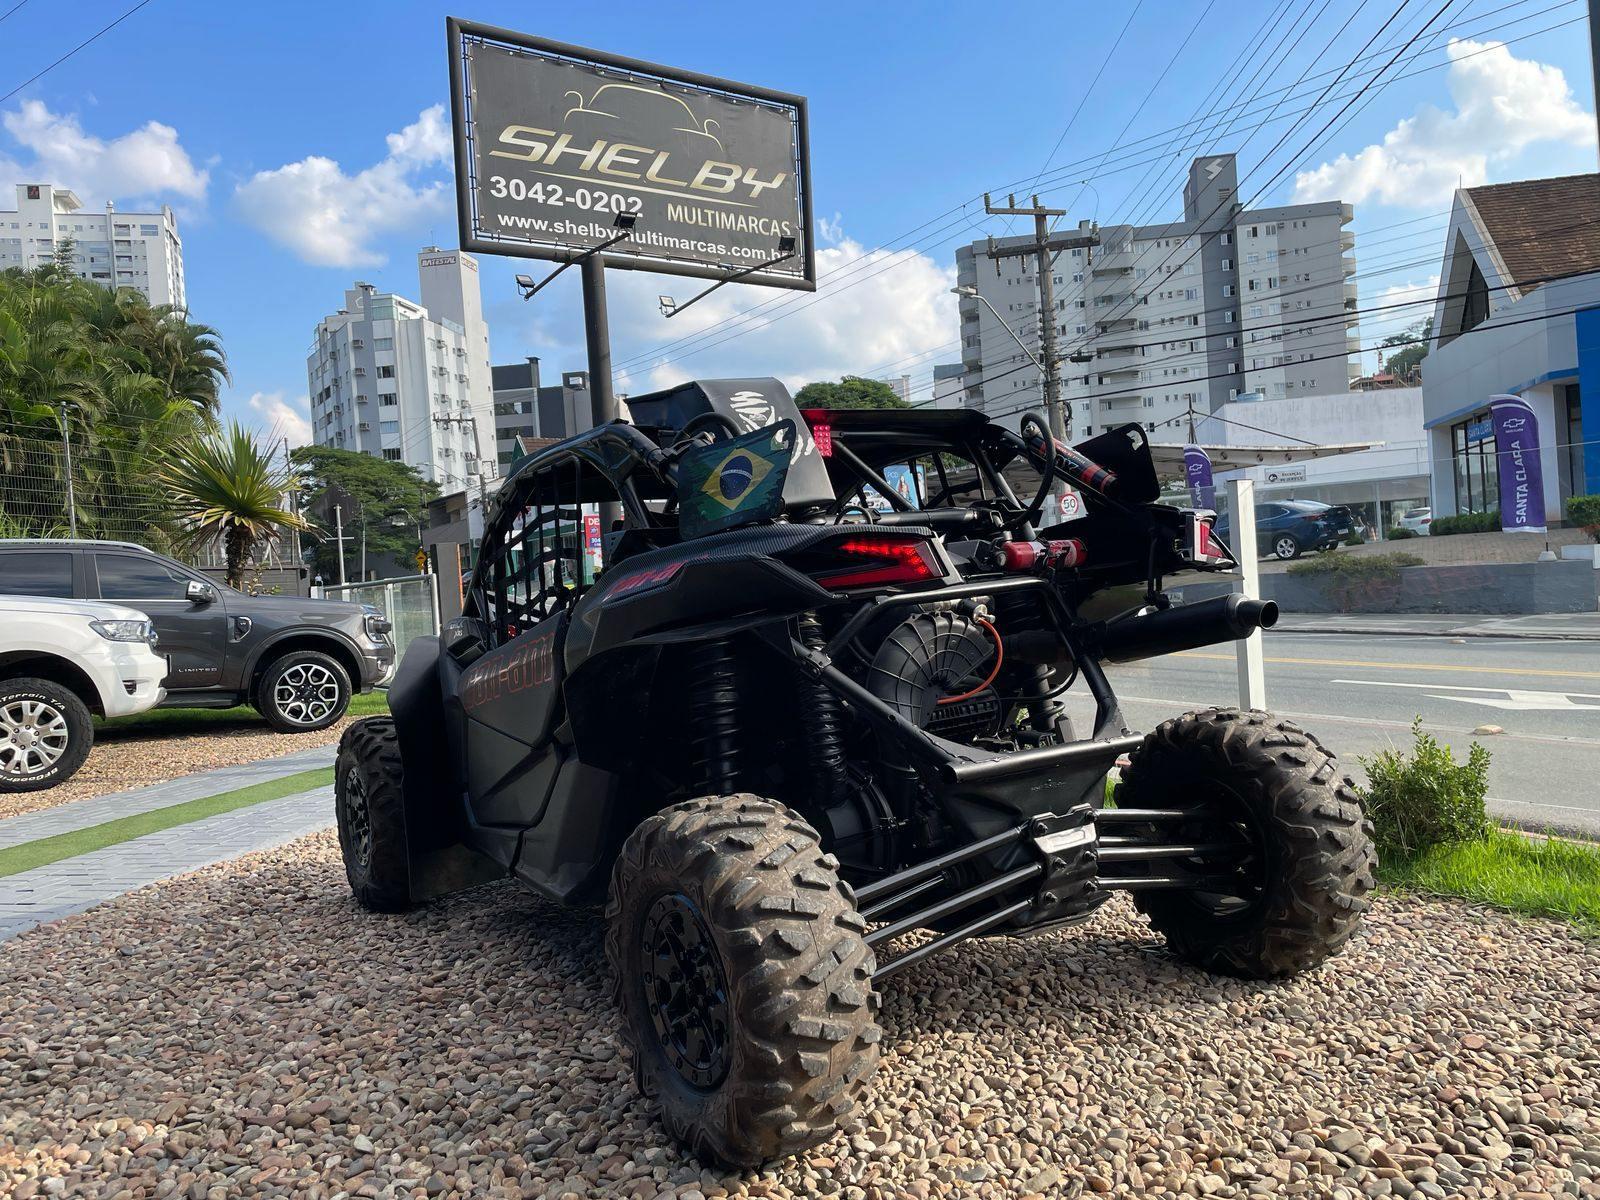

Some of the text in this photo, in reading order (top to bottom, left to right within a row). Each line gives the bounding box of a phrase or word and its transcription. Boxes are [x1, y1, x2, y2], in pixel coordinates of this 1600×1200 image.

[489, 125, 787, 198] SHELBY
[490, 175, 643, 218] 3042-0202
[667, 202, 791, 238] MULTIMARCAS
[1511, 440, 1528, 482] CLARA
[1063, 498, 1076, 509] 50
[1515, 483, 1529, 524] SANTA
[1, 693, 66, 712] Terrain T/A
